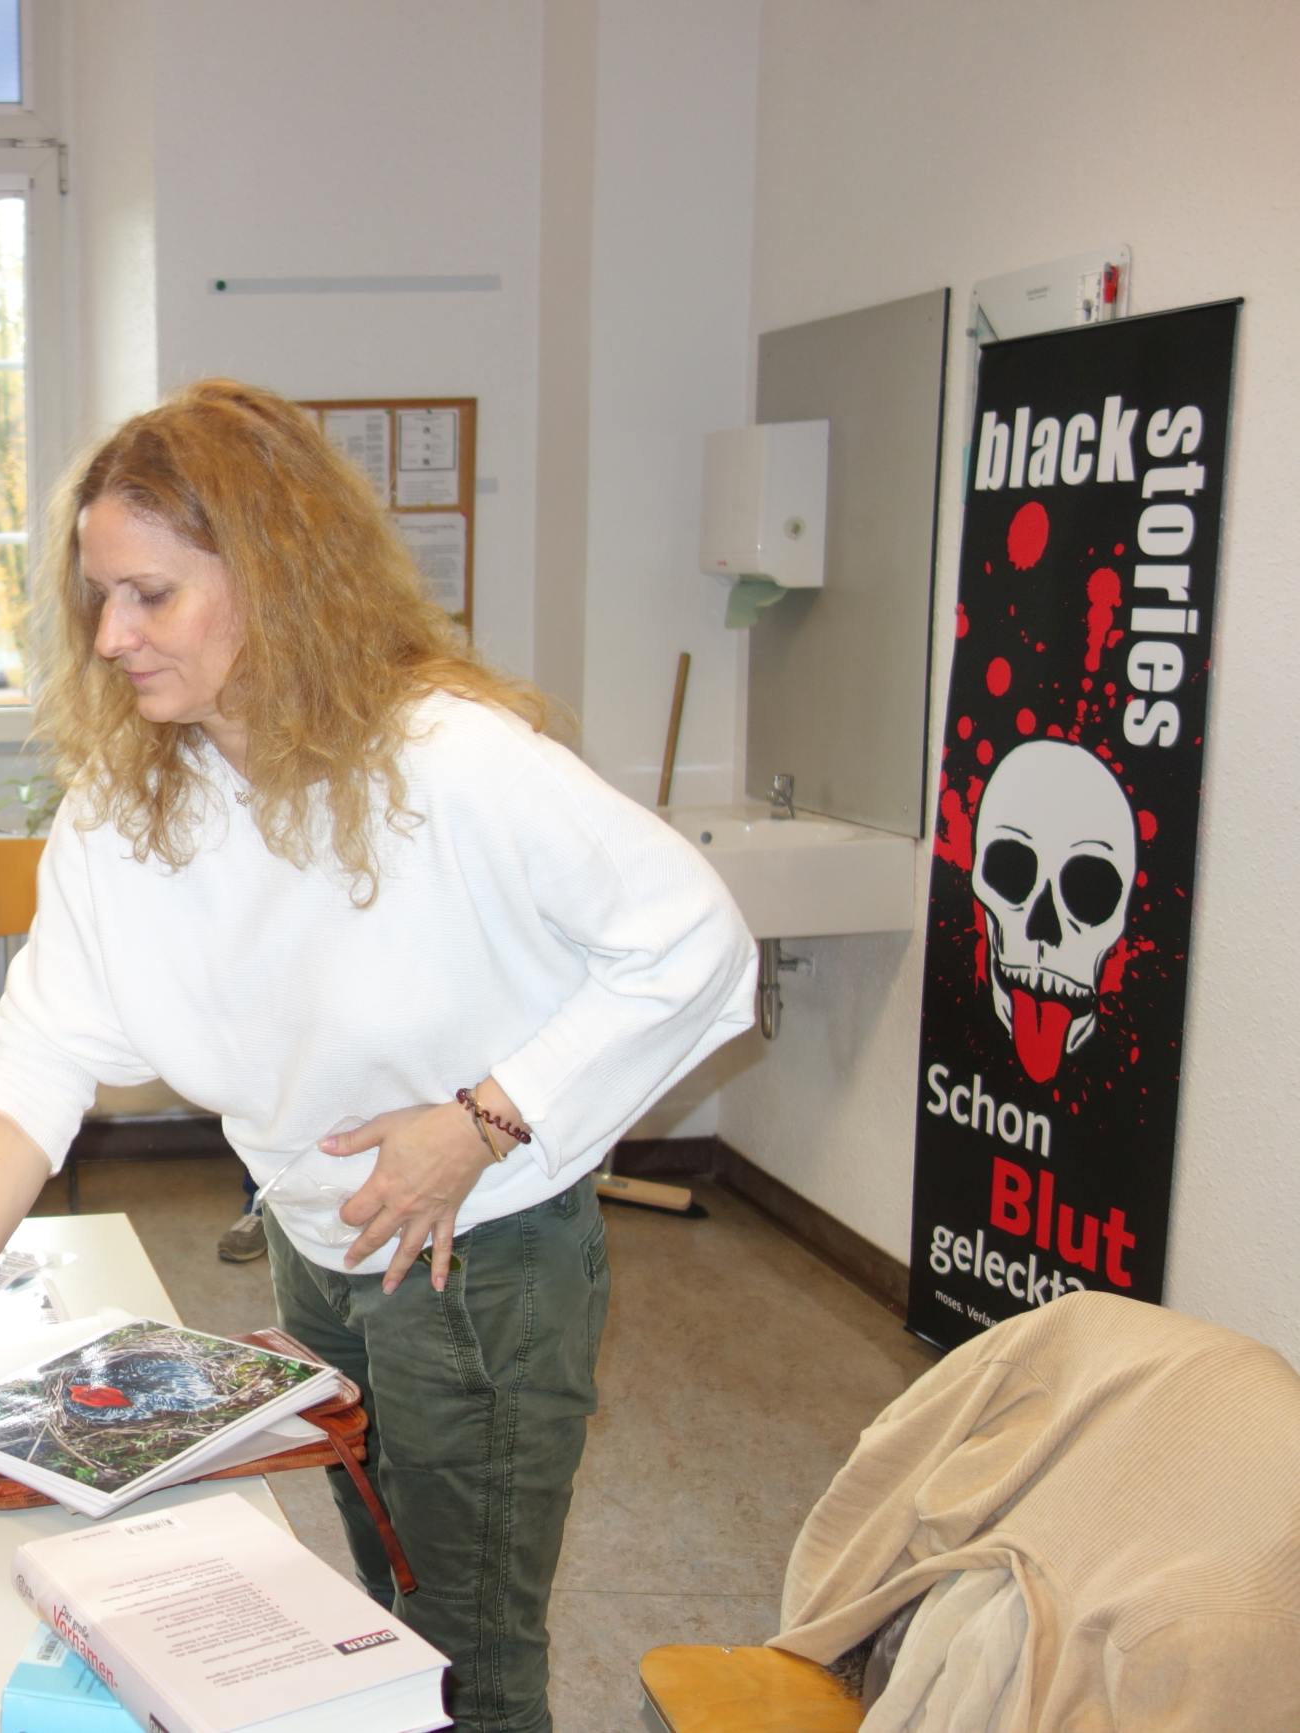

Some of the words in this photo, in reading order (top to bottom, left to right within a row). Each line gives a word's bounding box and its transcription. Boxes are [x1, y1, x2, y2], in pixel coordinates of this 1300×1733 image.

[975, 396, 1137, 491] black
[1123, 405, 1205, 748] stories
[927, 1063, 1051, 1158] Schon
[990, 1156, 1136, 1287] Blut
[935, 1290, 963, 1313] moses.
[53, 1604, 118, 1688] Vornamen-
[344, 1630, 395, 1651] DUDEN
